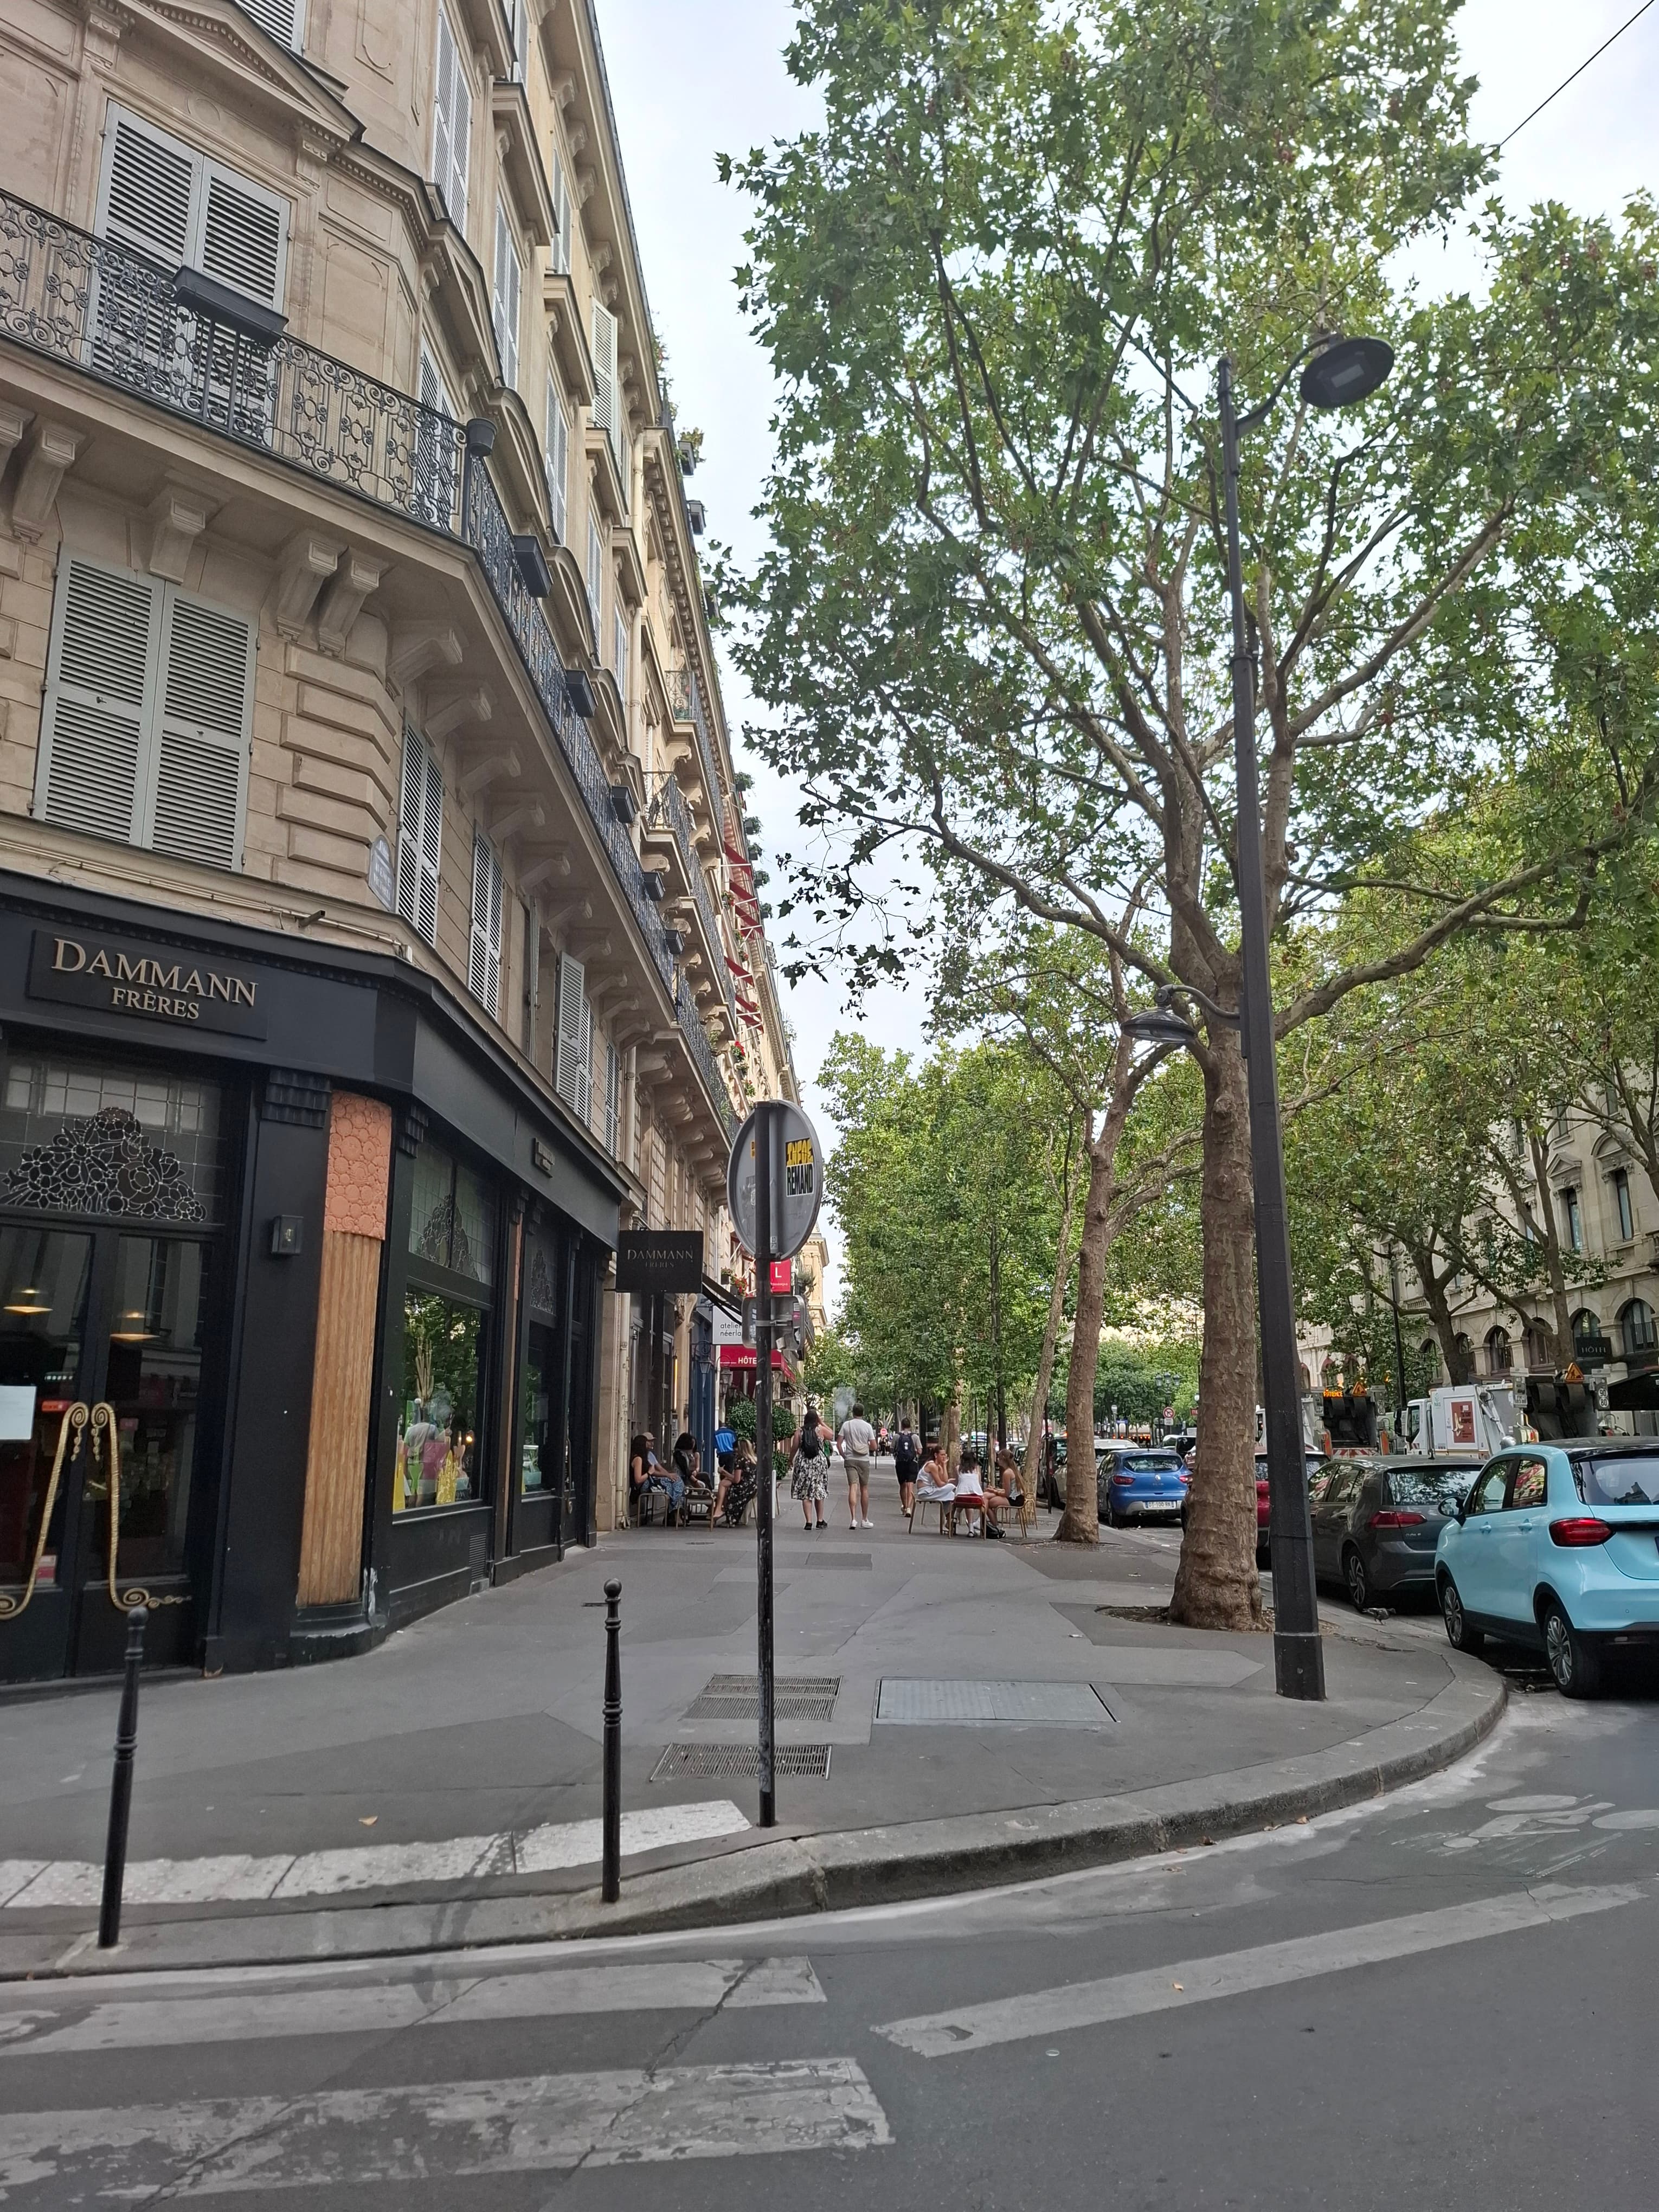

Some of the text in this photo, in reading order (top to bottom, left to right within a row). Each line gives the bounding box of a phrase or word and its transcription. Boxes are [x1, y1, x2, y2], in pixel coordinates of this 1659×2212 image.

[52, 938, 259, 1007] DAMMANN
[112, 987, 199, 1020] FRÈRES
[628, 1249, 693, 1259] DAMMANN
[738, 1356, 757, 1364] HÔTE
